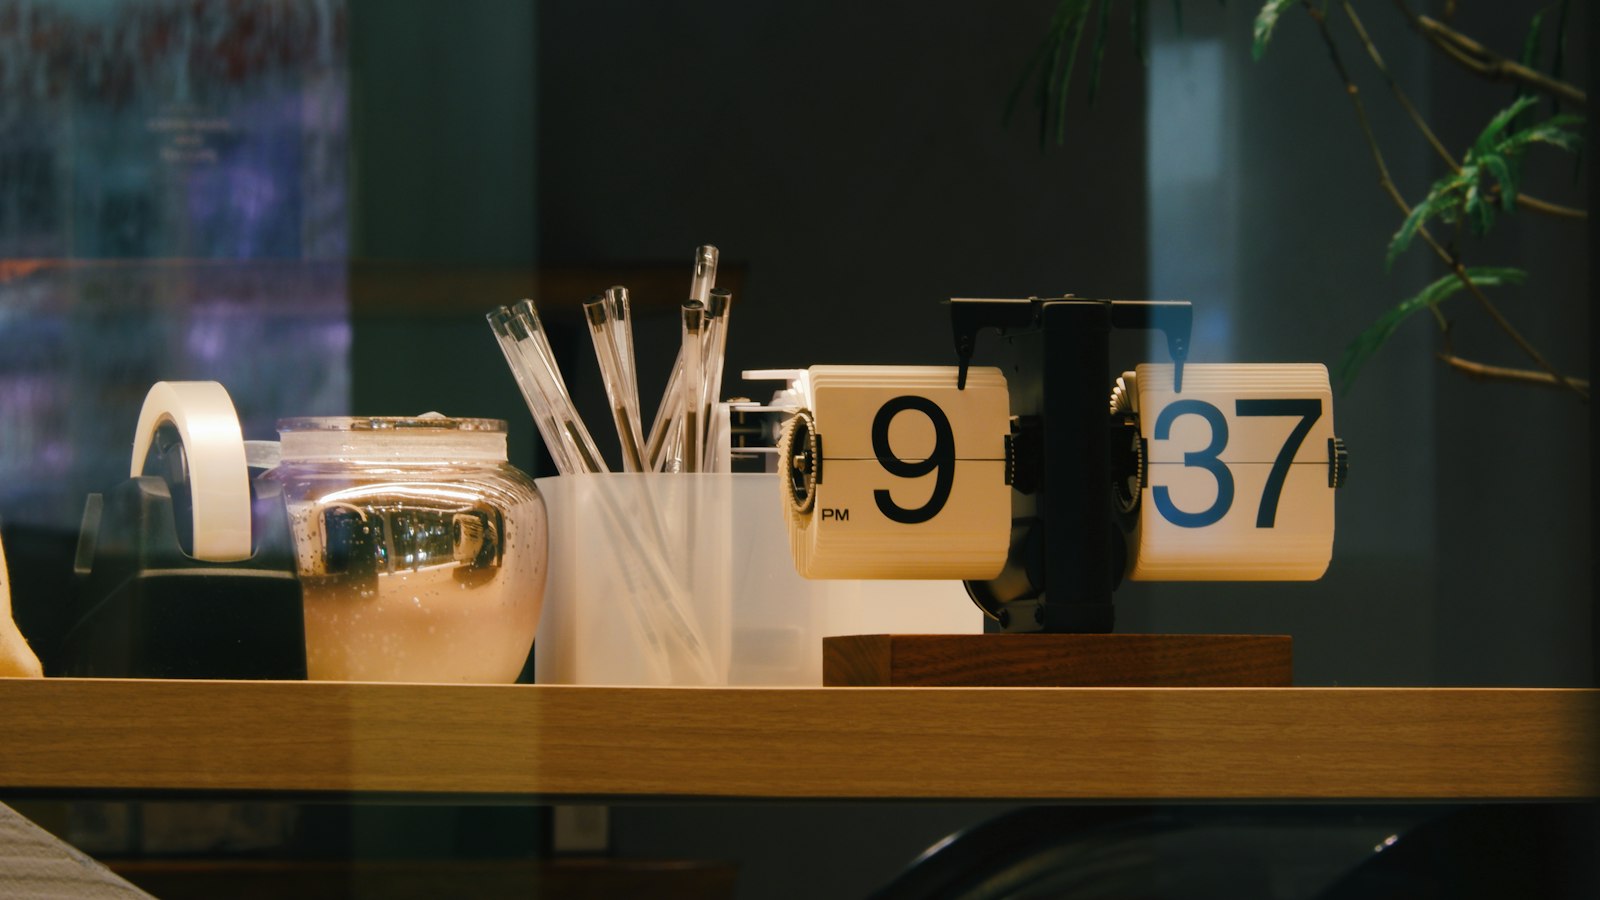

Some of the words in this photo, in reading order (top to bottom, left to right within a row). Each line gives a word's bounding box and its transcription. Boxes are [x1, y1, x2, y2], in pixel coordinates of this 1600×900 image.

[872, 395, 956, 525] 9
[1152, 399, 1323, 529] 37
[821, 508, 849, 521] PM
